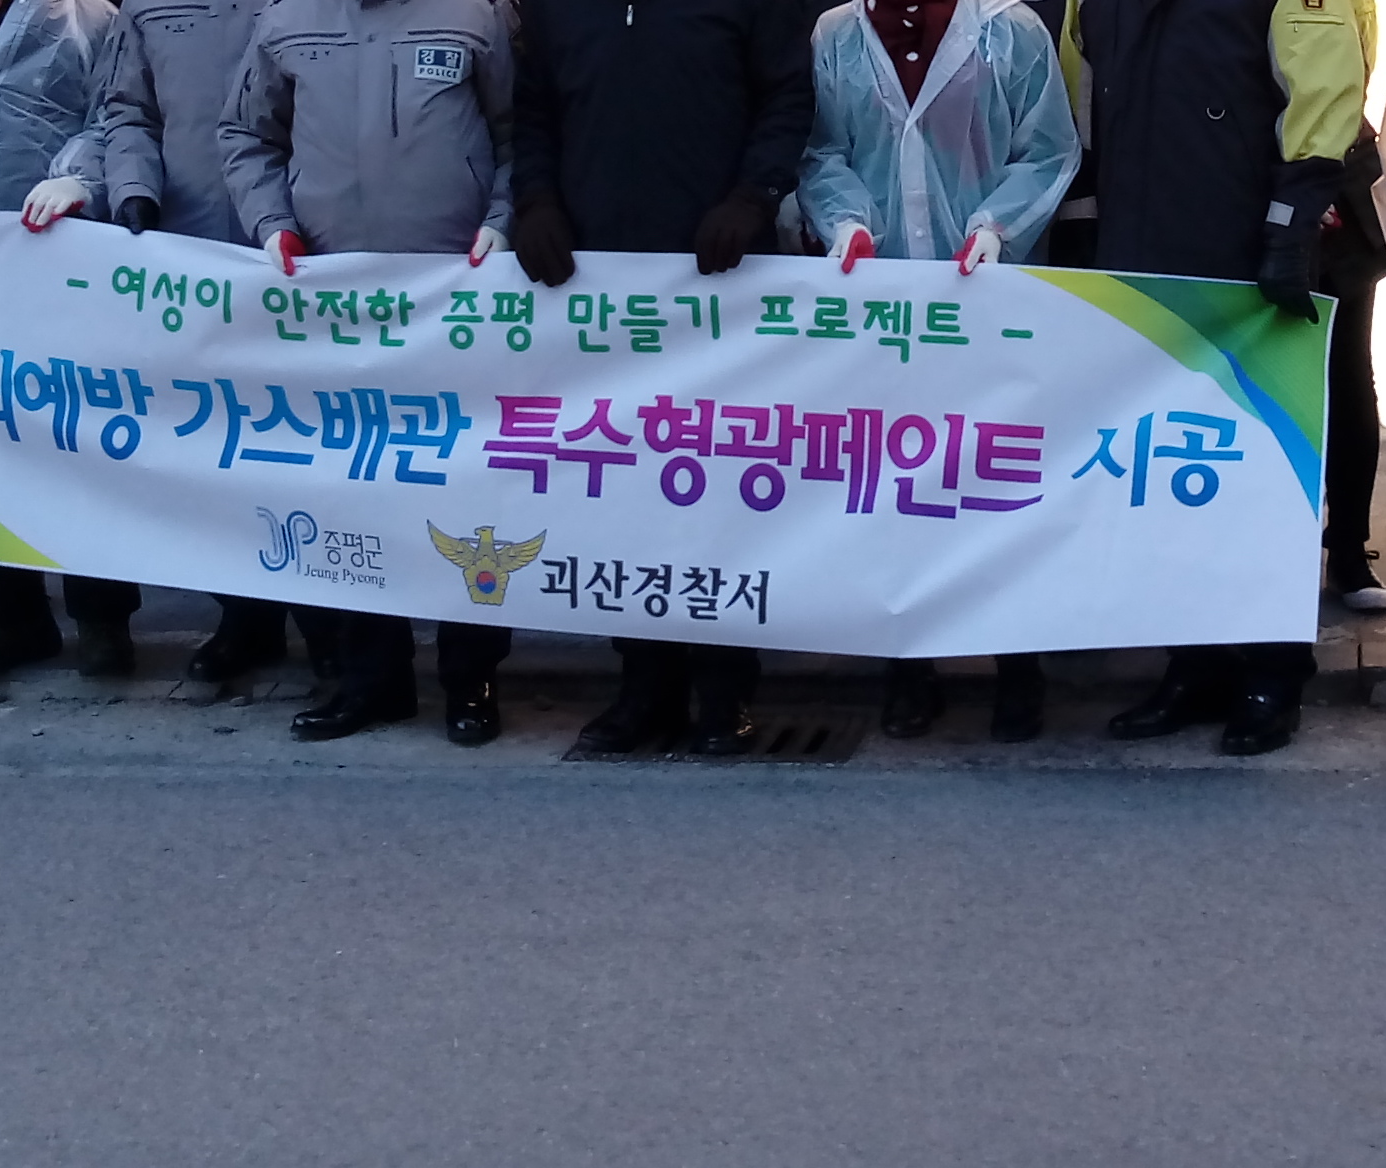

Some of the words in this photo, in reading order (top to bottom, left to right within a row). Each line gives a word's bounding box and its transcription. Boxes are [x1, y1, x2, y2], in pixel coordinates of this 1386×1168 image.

[419, 68, 459, 79] POLICE
[420, 50, 460, 68] 경찰
[113, 266, 232, 332] 여성이
[262, 287, 415, 347] 안전한
[442, 290, 535, 352] 증평
[567, 293, 721, 353] 만들기
[755, 294, 970, 364] 프로젝트
[172, 378, 472, 486] 가스배관
[482, 394, 1045, 520] 특수형광페인트
[1071, 410, 1244, 507] 시공
[323, 530, 384, 570] 증평군
[304, 564, 339, 584] Jeung
[342, 570, 387, 589] Pyeong
[539, 555, 770, 625] 괴산경찰서
